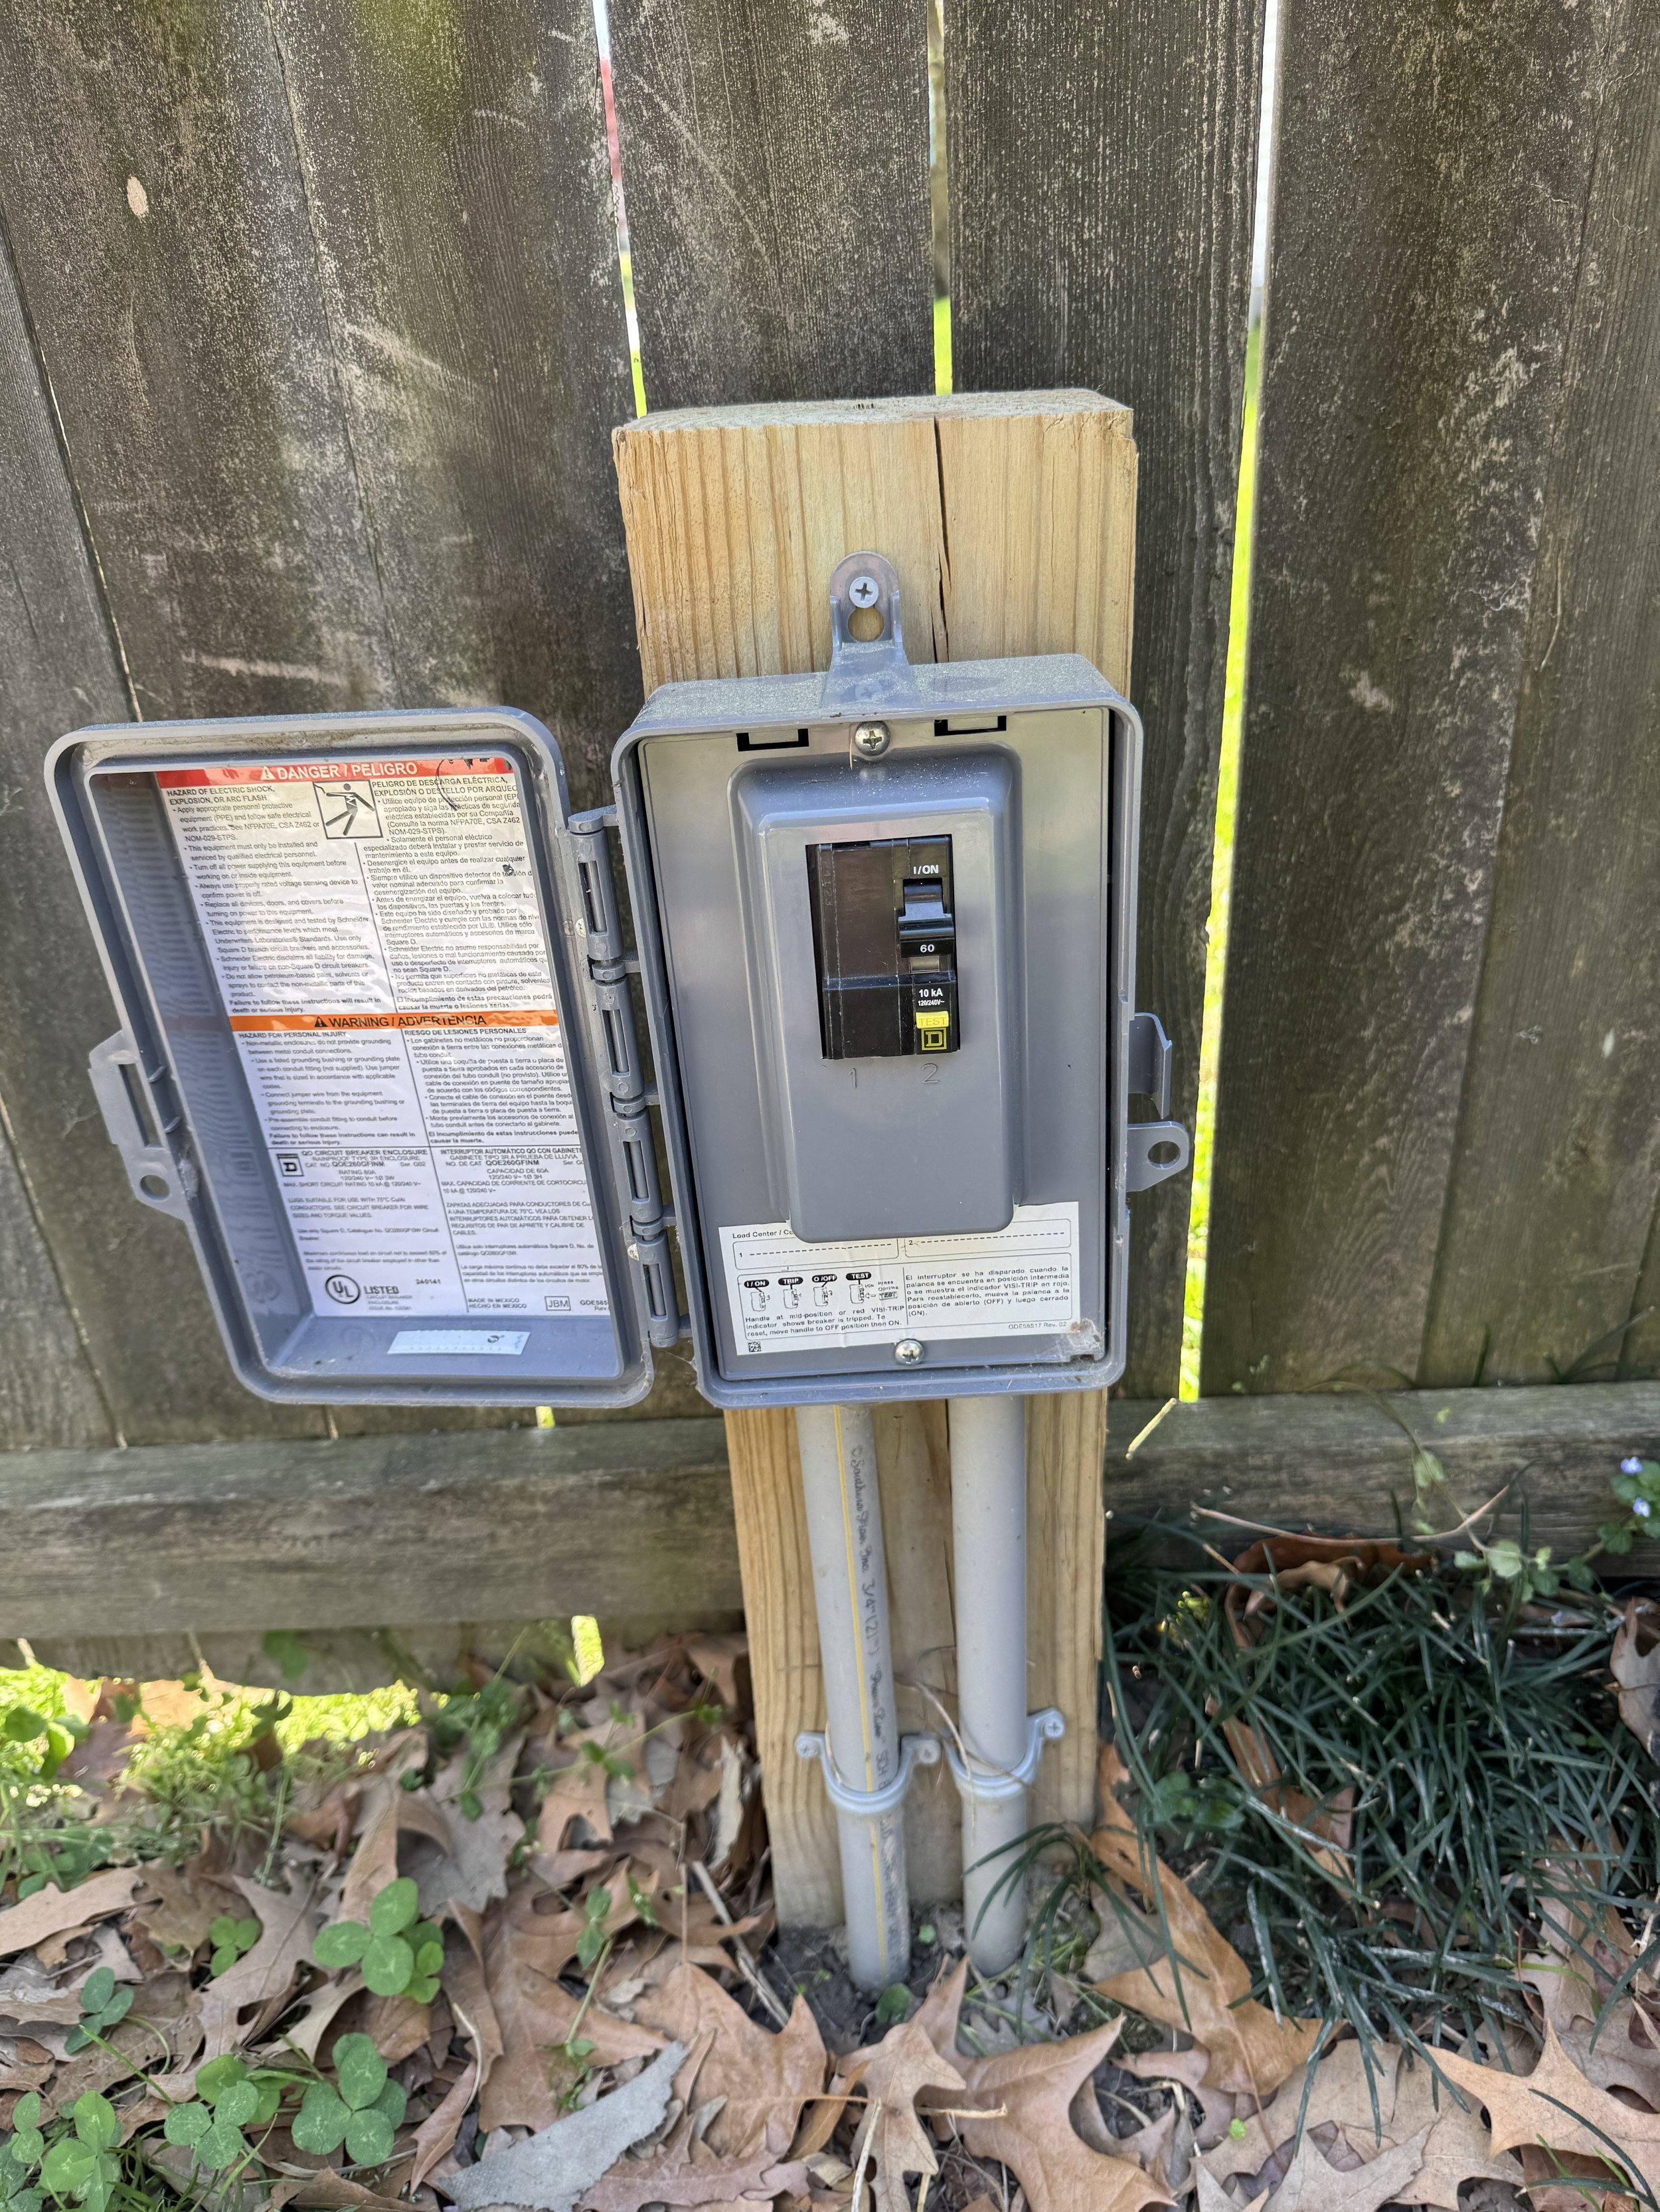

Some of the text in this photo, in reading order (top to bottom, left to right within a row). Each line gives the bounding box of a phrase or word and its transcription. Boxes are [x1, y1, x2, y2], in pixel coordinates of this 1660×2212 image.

[278, 763, 417, 779] DANGER / PELIGRO
[914, 865, 938, 874] I/ON
[920, 944, 934, 953] 60
[931, 988, 943, 996] kA
[329, 1015, 487, 1028] WARNING / ADVERTENCIA
[919, 1016, 947, 1026] TEST
[849, 1063, 940, 1088] 1 2
[997, 1275, 1027, 1284] posición
